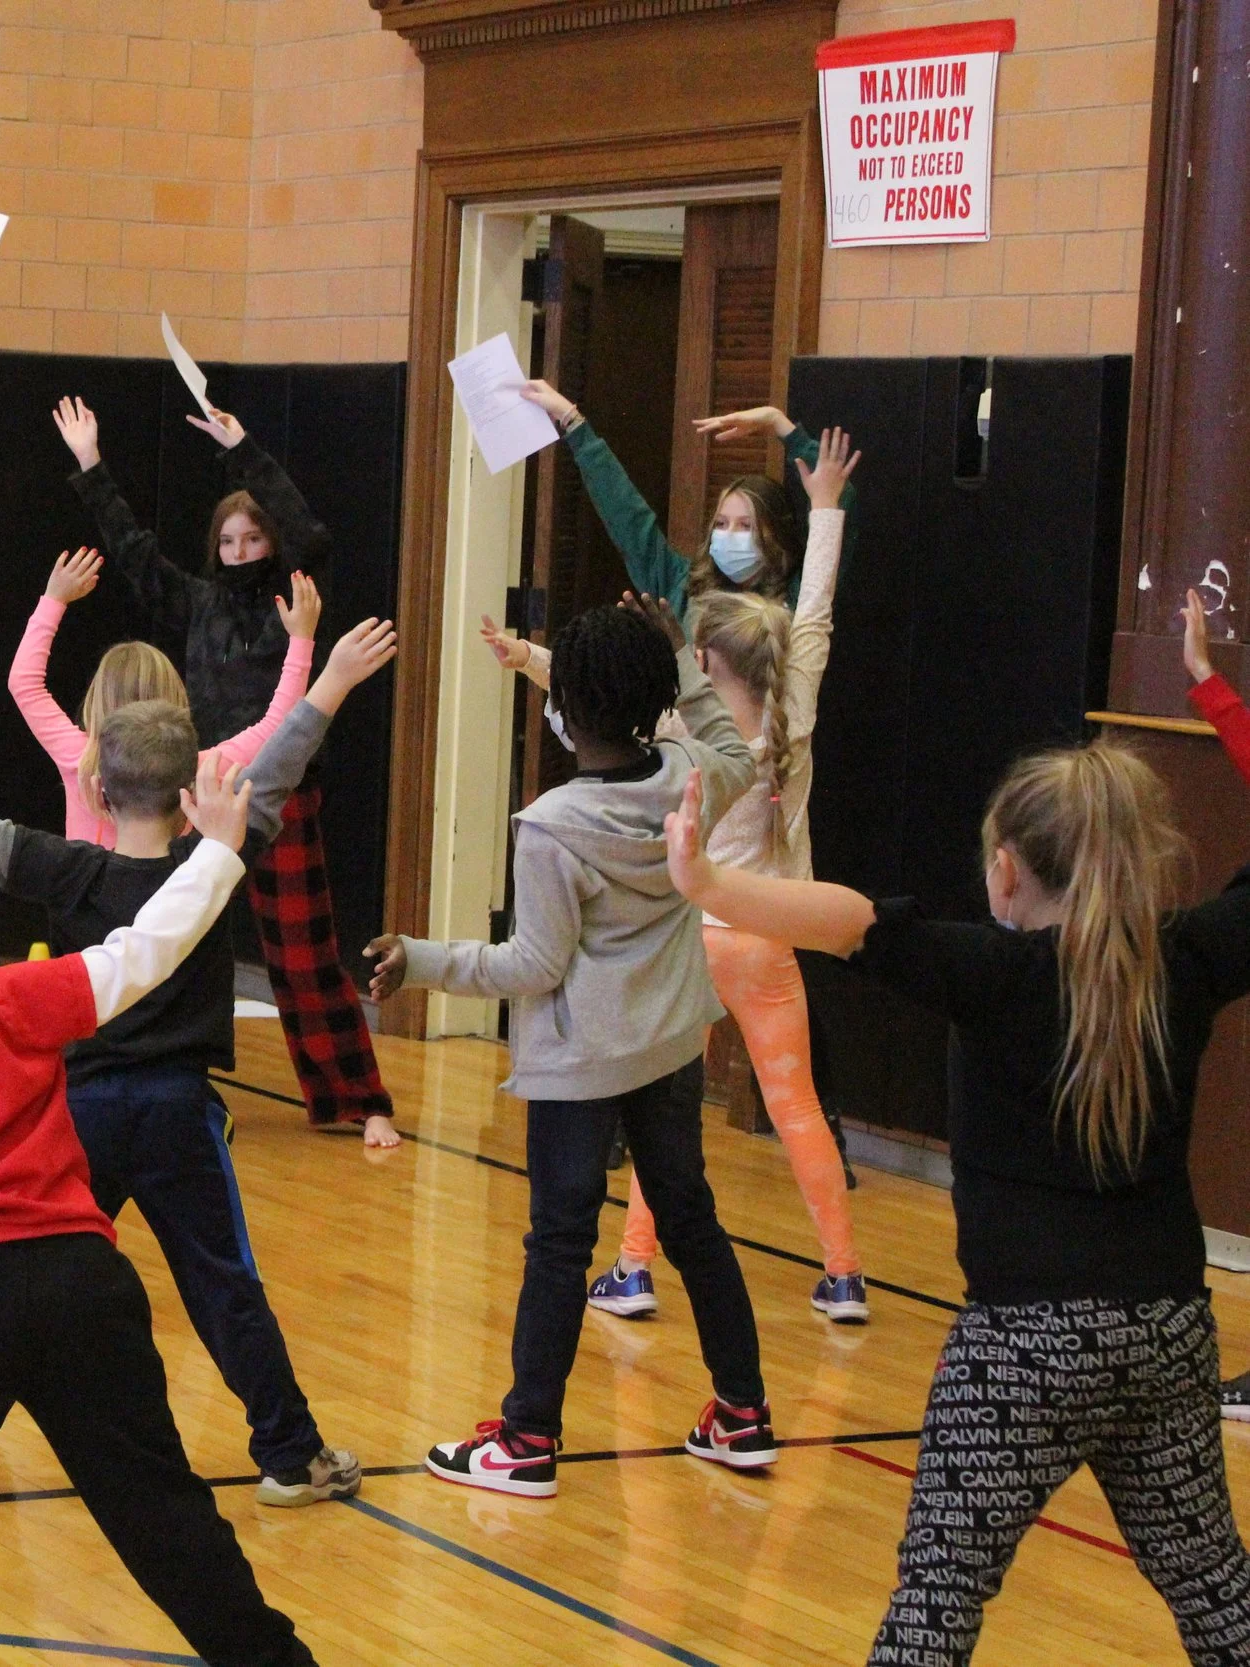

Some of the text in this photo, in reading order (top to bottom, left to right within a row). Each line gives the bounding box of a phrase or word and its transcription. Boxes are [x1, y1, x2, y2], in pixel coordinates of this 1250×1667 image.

[859, 61, 967, 105] MAXIMUM
[850, 106, 974, 150] OCCUPANCY
[859, 151, 963, 181] NOT TO EXCEED
[834, 193, 871, 224] 460
[883, 183, 972, 223] PERSONS
[1073, 1308, 1129, 1332] KLEIN
[1008, 1331, 1083, 1352] CALVIN
[1095, 1322, 1149, 1349] KLEIN
[1166, 1321, 1207, 1362] KLEIN
[968, 1344, 1019, 1364] KLEIN
[1030, 1352, 1104, 1371] CALVIN
[1106, 1341, 1161, 1367] KLEIN
[986, 1364, 1042, 1388] KLEIN
[1044, 1370, 1116, 1391] CALVIN
[931, 1383, 983, 1404] CALVIN
[987, 1383, 1042, 1405] KLEIN
[935, 1405, 999, 1426] CALVIN
[1009, 1404, 1061, 1425] KLEIN
[936, 1426, 1001, 1446] CALVIN
[1004, 1426, 1055, 1446] KLEIN
[948, 1448, 1017, 1469] CALVIN
[1023, 1445, 1068, 1467] KLEIN
[1140, 1441, 1193, 1470] KLEIN
[913, 1464, 1072, 1489] LEIN CALVIN KLEIN
[1141, 1463, 1194, 1488] KLEIN
[919, 1489, 963, 1510] KLEIN
[966, 1487, 1035, 1509] CALVIN
[943, 1526, 995, 1547] KLEIN
[1146, 1532, 1211, 1558] CALVIN
[894, 1625, 946, 1649] KLEIN
[900, 1647, 955, 1667] KLEIN
